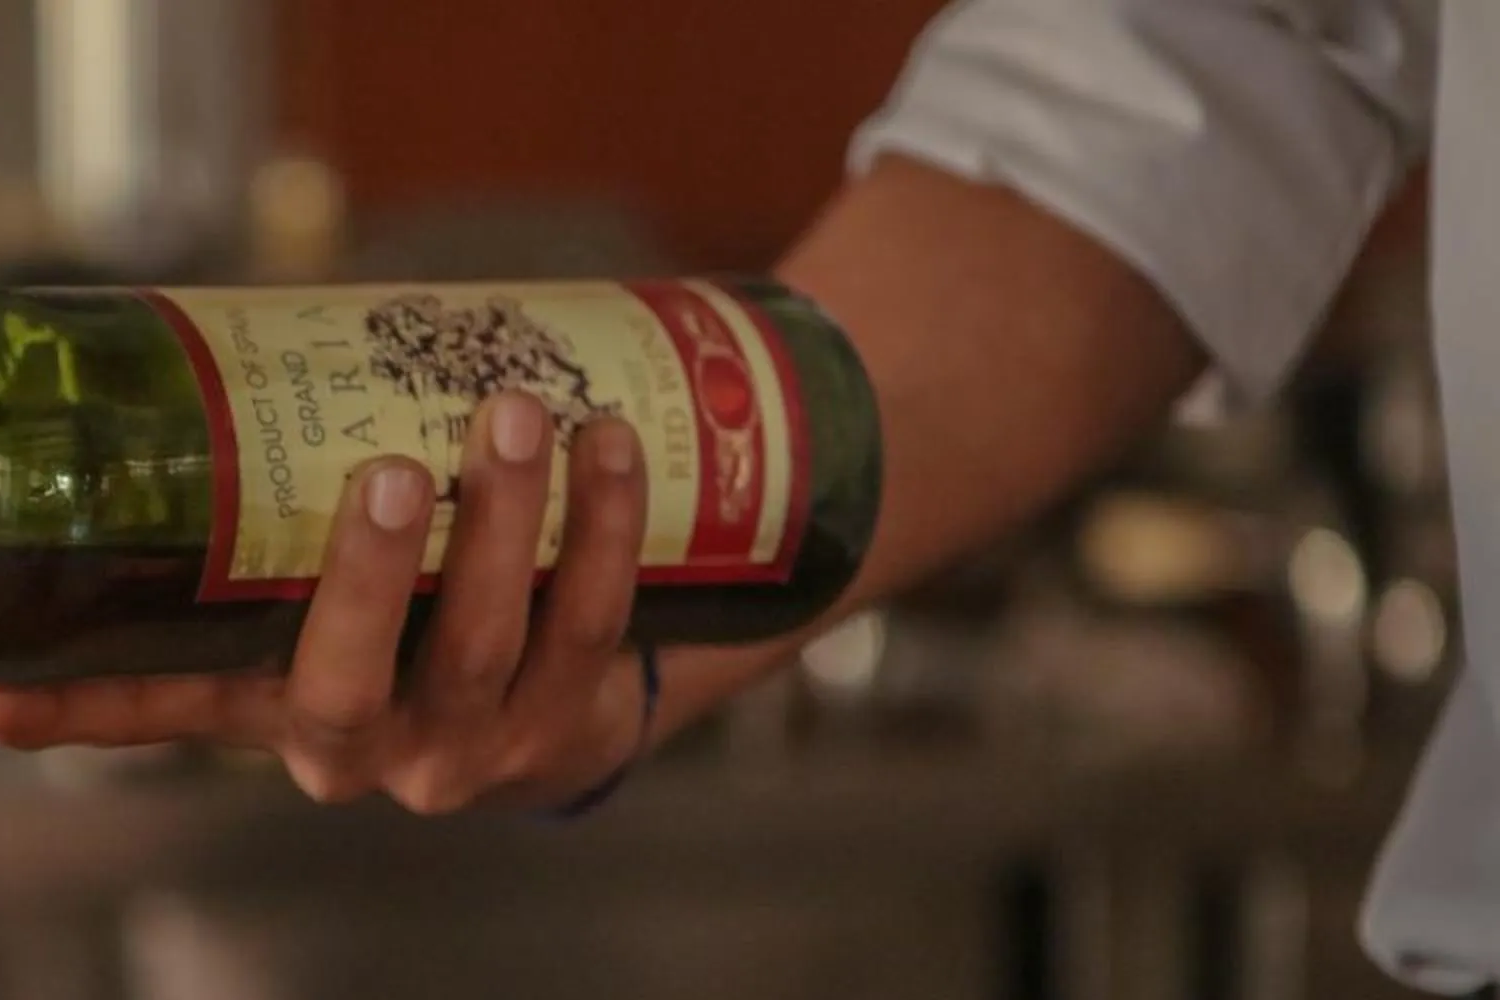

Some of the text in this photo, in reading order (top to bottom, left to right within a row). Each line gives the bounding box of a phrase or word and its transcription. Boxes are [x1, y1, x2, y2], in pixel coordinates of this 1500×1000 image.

[240, 361, 269, 391] OF
[281, 350, 327, 448] GRAND
[296, 303, 380, 480] ARIA
[251, 396, 301, 520] PRODUCT
[663, 407, 692, 480] RED
